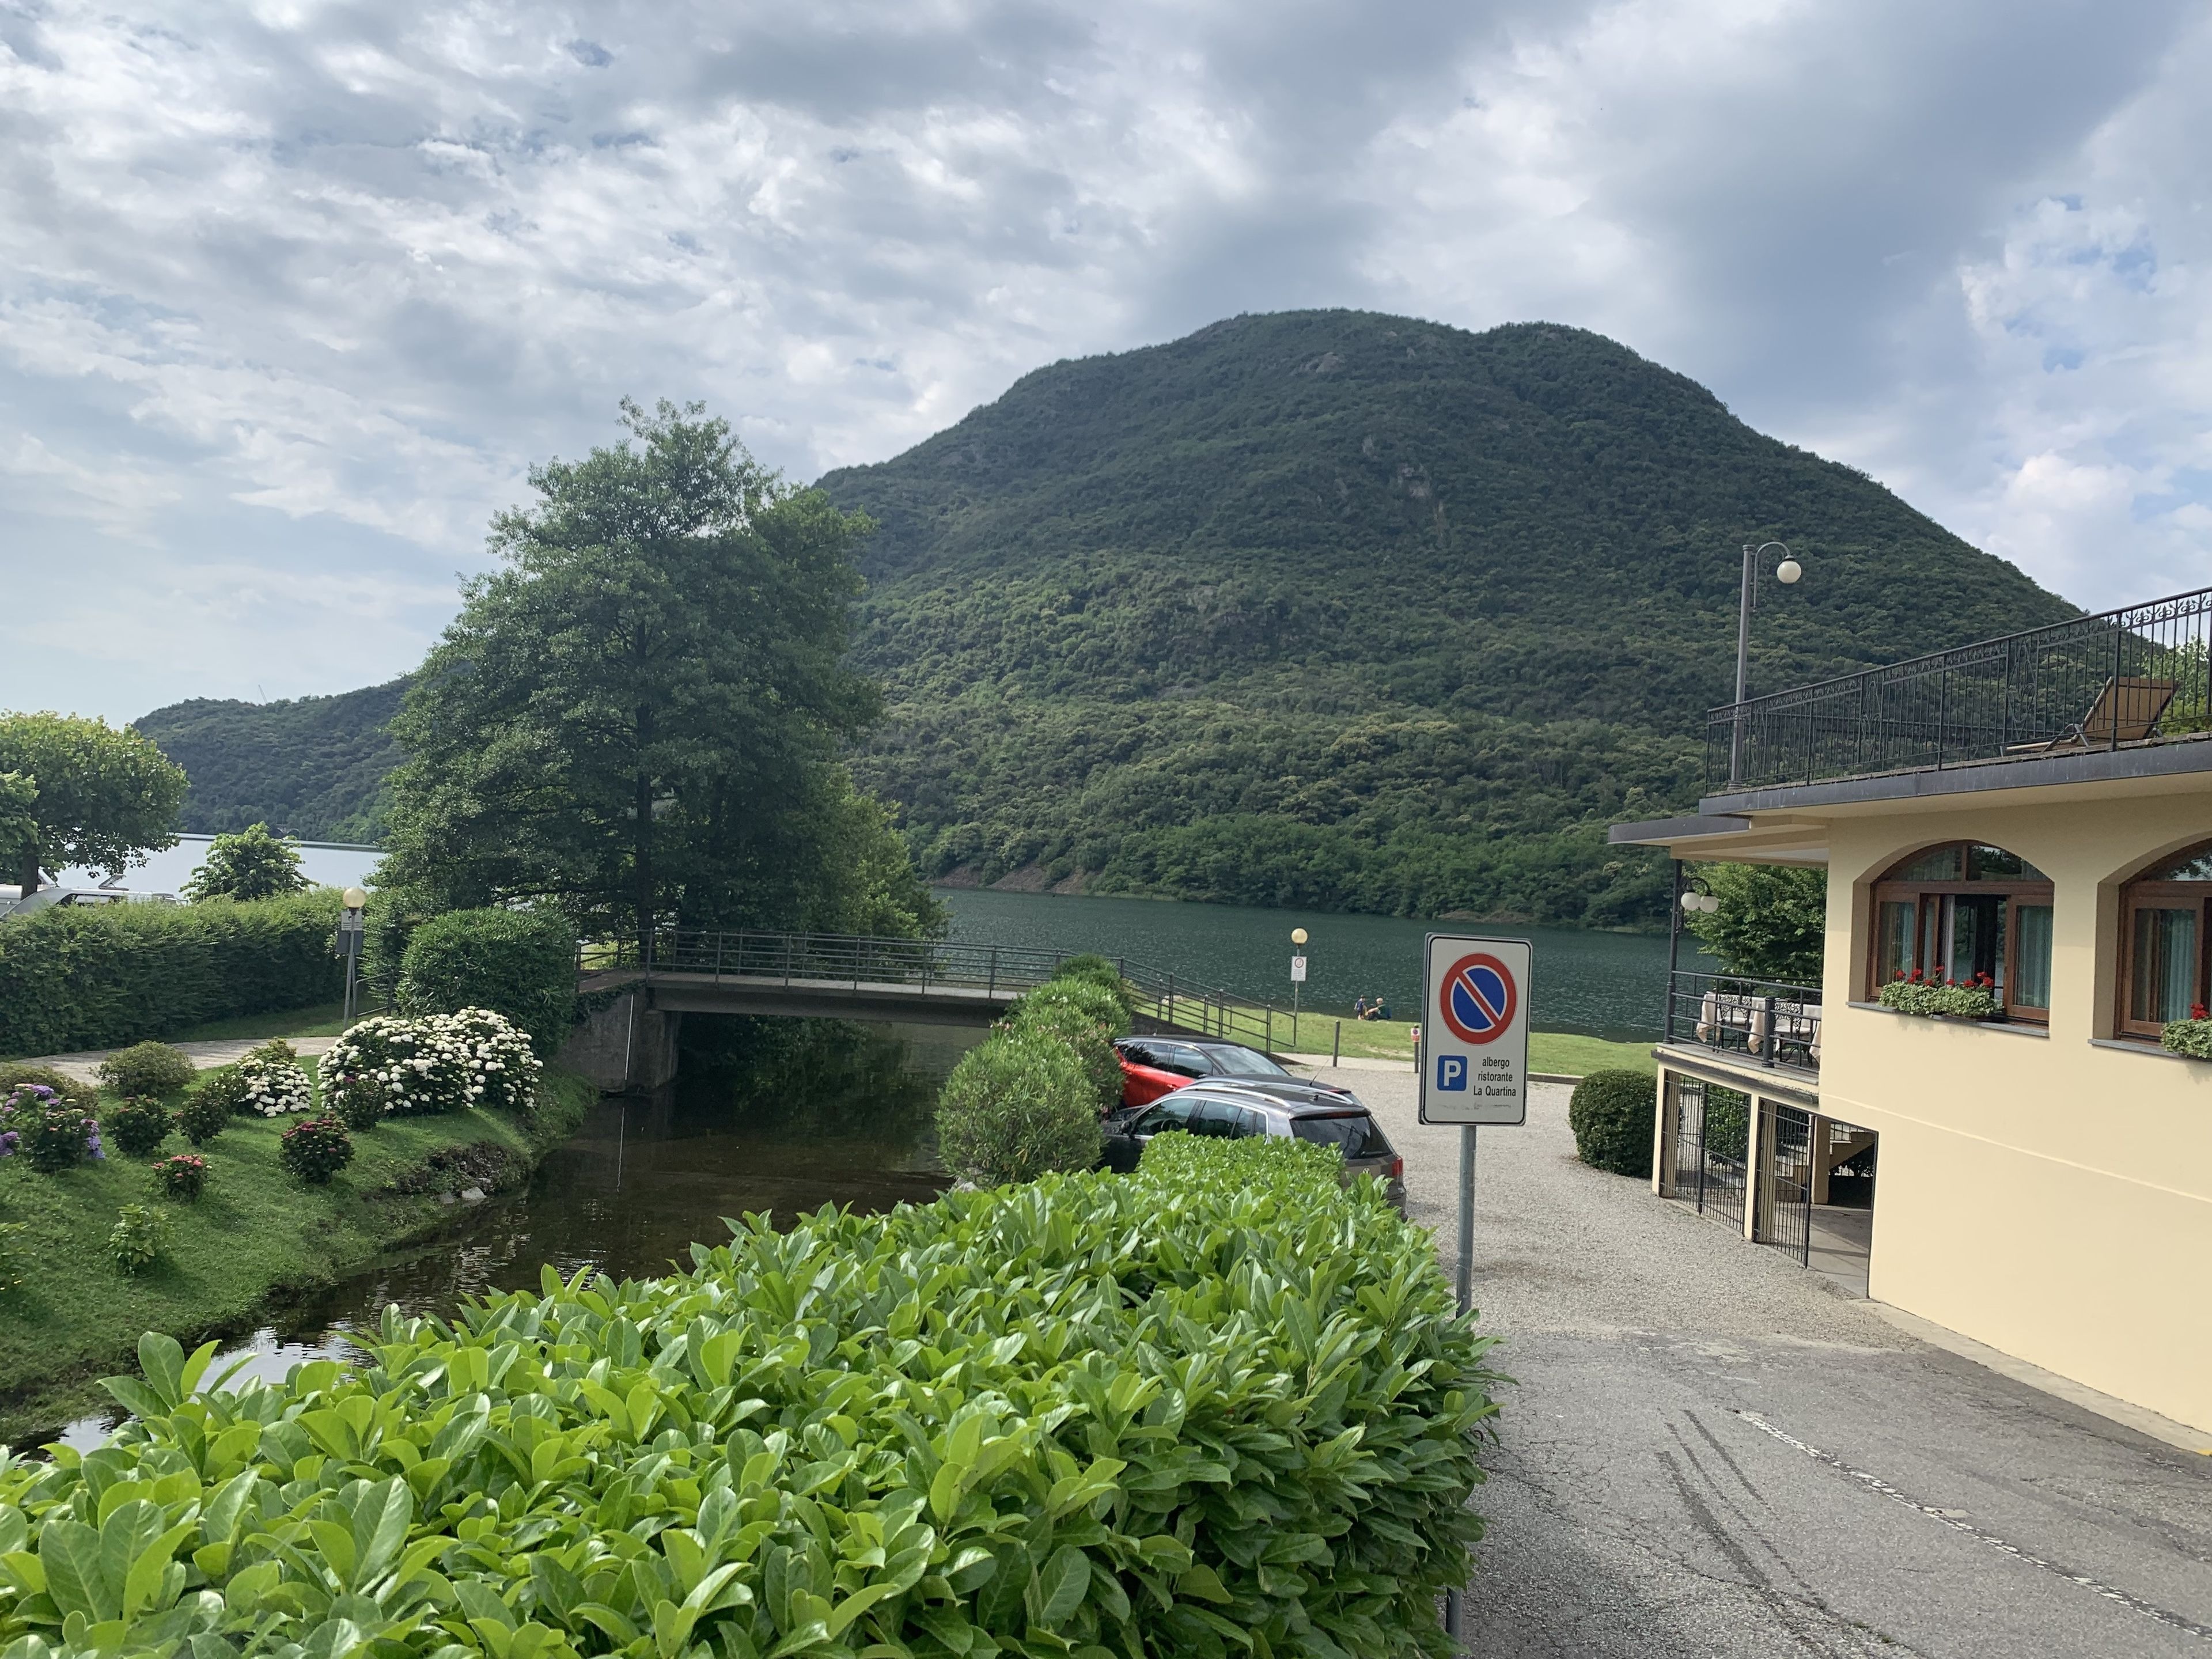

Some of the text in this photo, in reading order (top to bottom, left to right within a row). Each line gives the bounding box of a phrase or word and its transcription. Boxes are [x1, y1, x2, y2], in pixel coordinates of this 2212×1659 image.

[1482, 1056, 1510, 1069] albergo
[1444, 1060, 1461, 1086] P
[1478, 1071, 1513, 1082] ristorante
[1474, 1085, 1516, 1096] La Quartina
